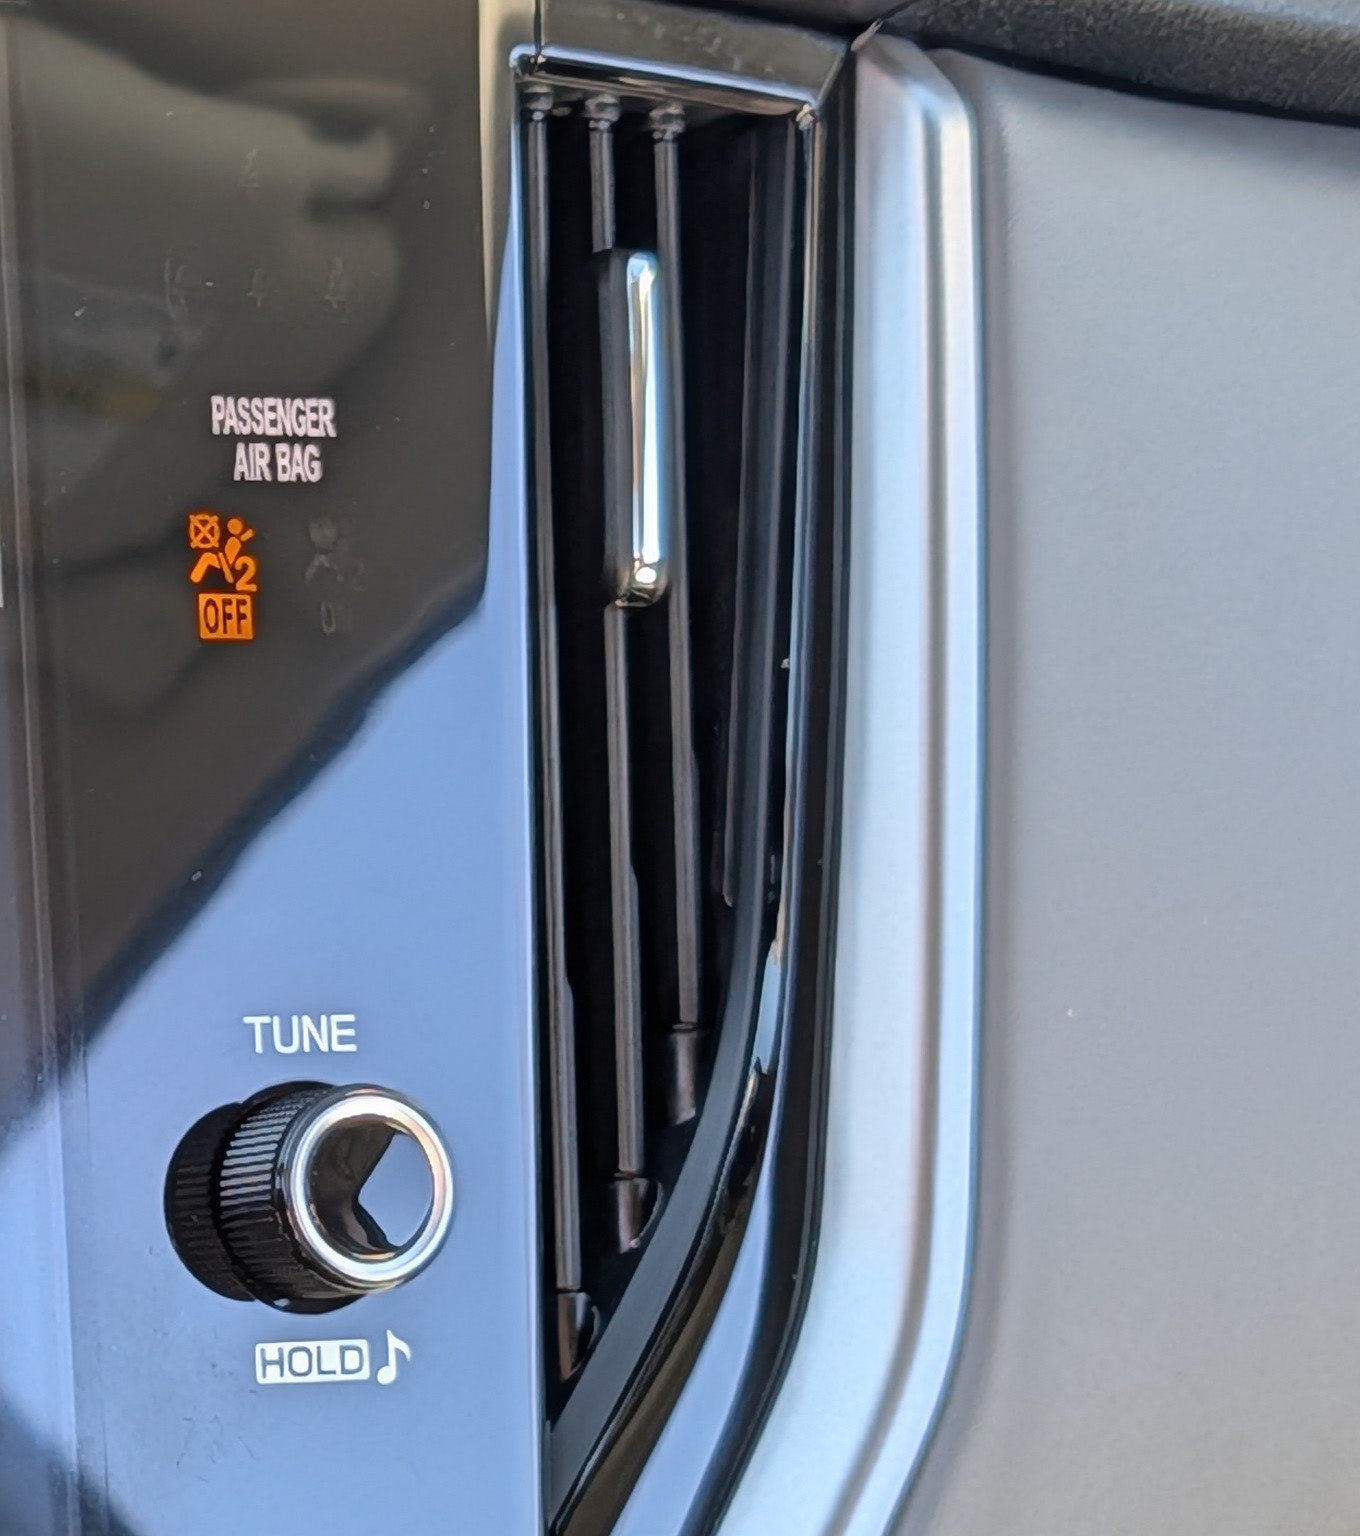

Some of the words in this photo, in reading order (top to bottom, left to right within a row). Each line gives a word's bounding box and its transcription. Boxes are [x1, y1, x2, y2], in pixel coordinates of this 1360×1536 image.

[210, 395, 338, 438] PASSENGER
[233, 442, 274, 482] AIR
[275, 443, 324, 483] BAG
[201, 596, 251, 637] OFF
[242, 1013, 359, 1055] TUNE
[258, 1342, 367, 1380] HOLD
